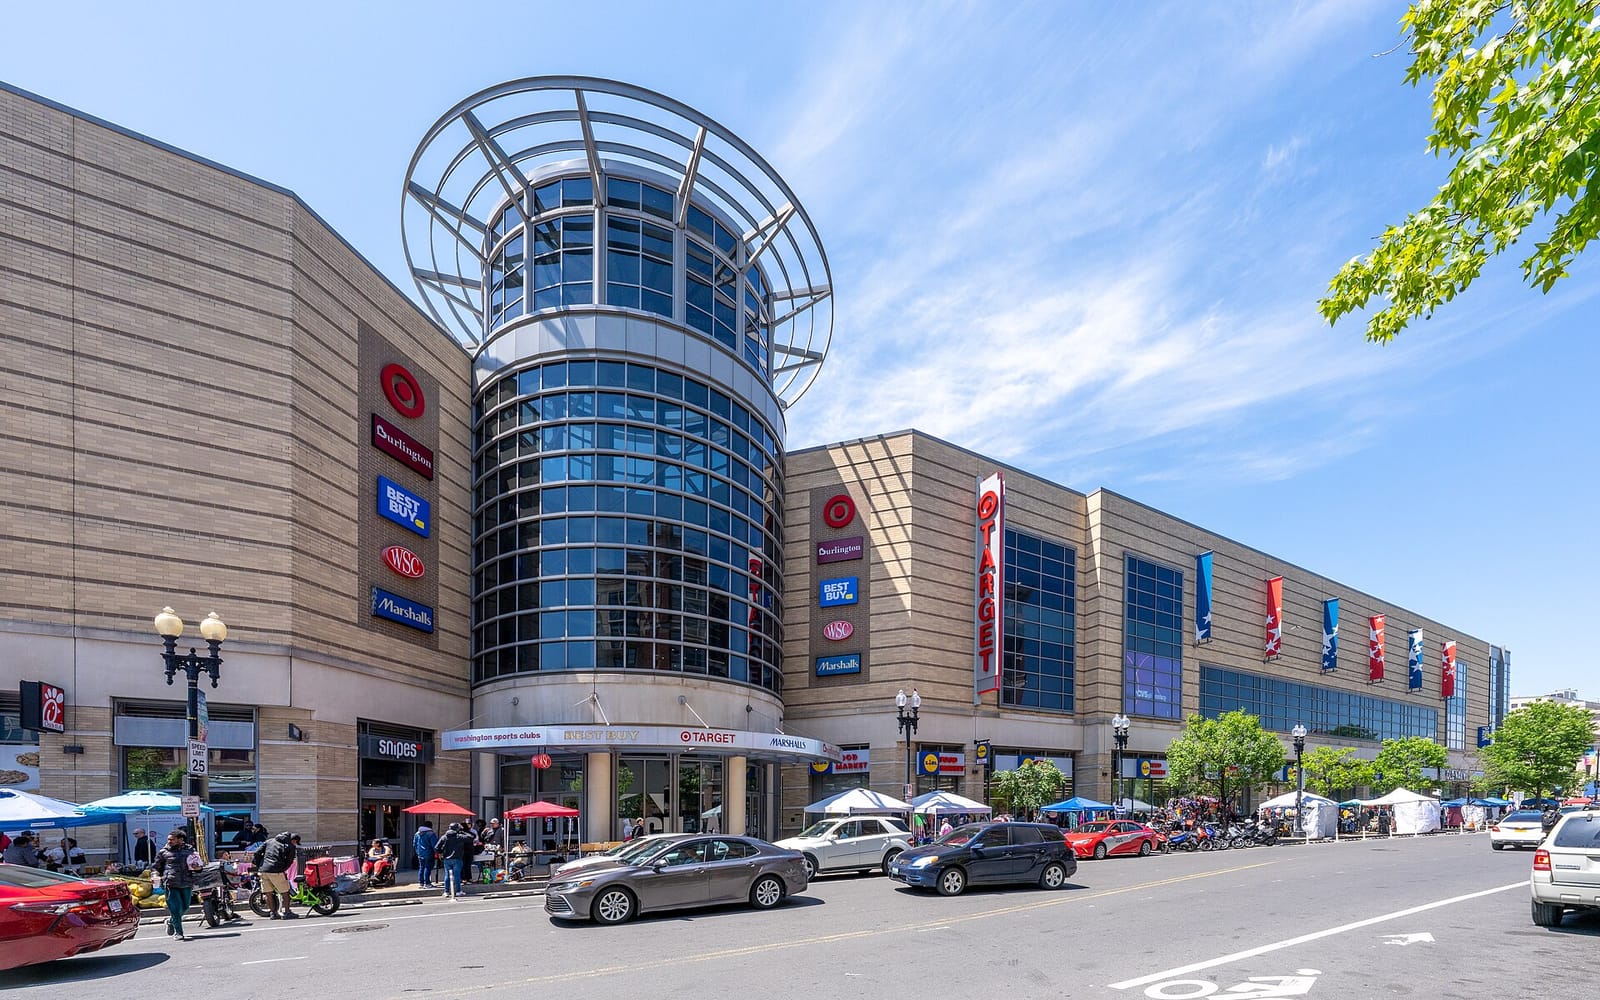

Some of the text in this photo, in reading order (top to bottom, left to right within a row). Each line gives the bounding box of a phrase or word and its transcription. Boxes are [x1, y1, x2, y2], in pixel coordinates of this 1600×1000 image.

[377, 425, 431, 469] Burlington
[387, 486, 420, 512] BEST
[389, 500, 417, 522] BUY
[819, 544, 861, 556] Burlington
[391, 548, 420, 575] WSC
[824, 582, 849, 593] BEST
[826, 591, 847, 601] BUY
[979, 520, 996, 672] TARGET
[378, 598, 432, 626] Marshalls
[827, 622, 850, 639] WSC
[818, 659, 859, 671] Marshalls
[454, 731, 541, 742] washington sports clubs
[564, 730, 640, 740] BEST BUY
[692, 731, 736, 743] TARGET
[379, 739, 417, 759] snipes
[769, 738, 807, 749] MARSHALLS
[192, 759, 205, 772] 25
